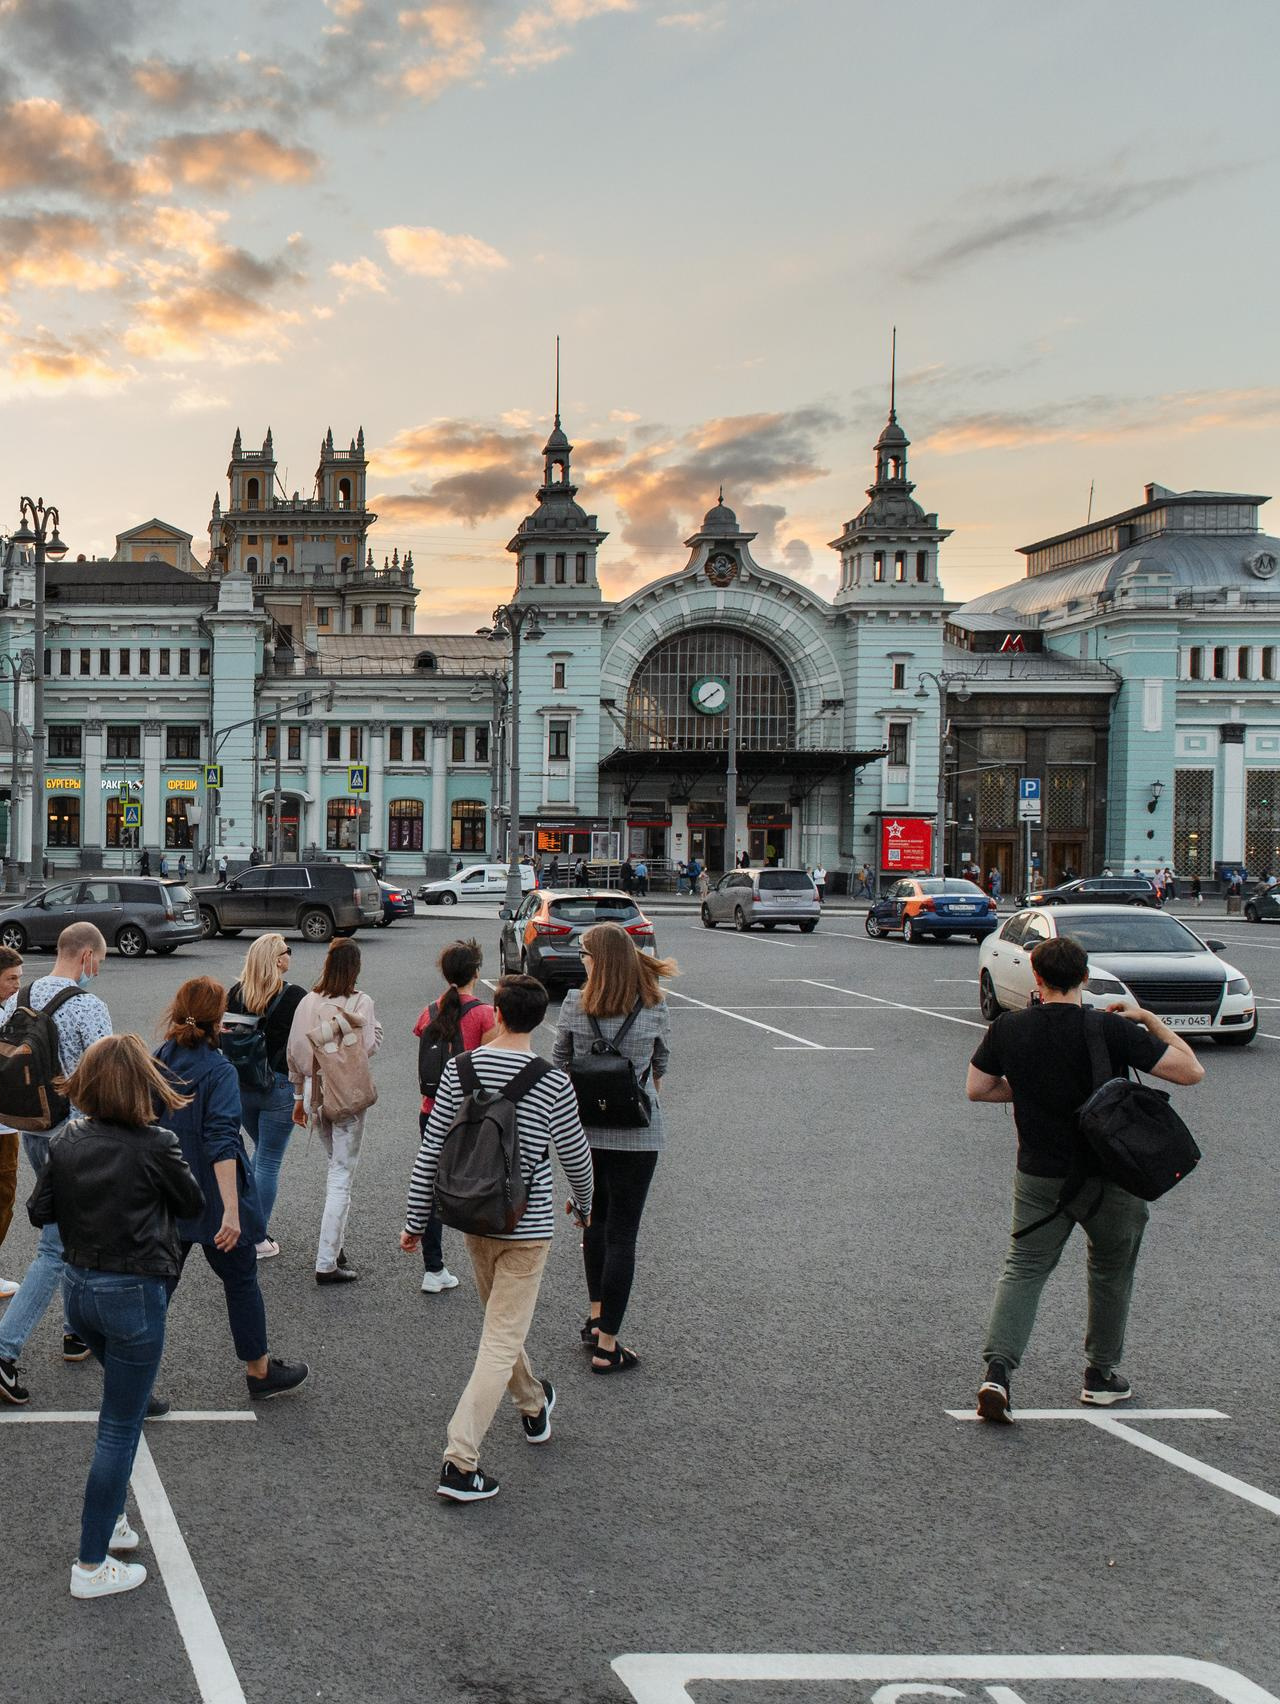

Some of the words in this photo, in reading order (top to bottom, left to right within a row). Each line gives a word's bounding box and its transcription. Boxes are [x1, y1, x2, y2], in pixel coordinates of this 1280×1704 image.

[46, 778, 81, 790] БУРГЕРЫ
[167, 779, 198, 790] ФРЕШИ
[1025, 781, 1036, 797] P
[1188, 1017, 1206, 1025] 045
